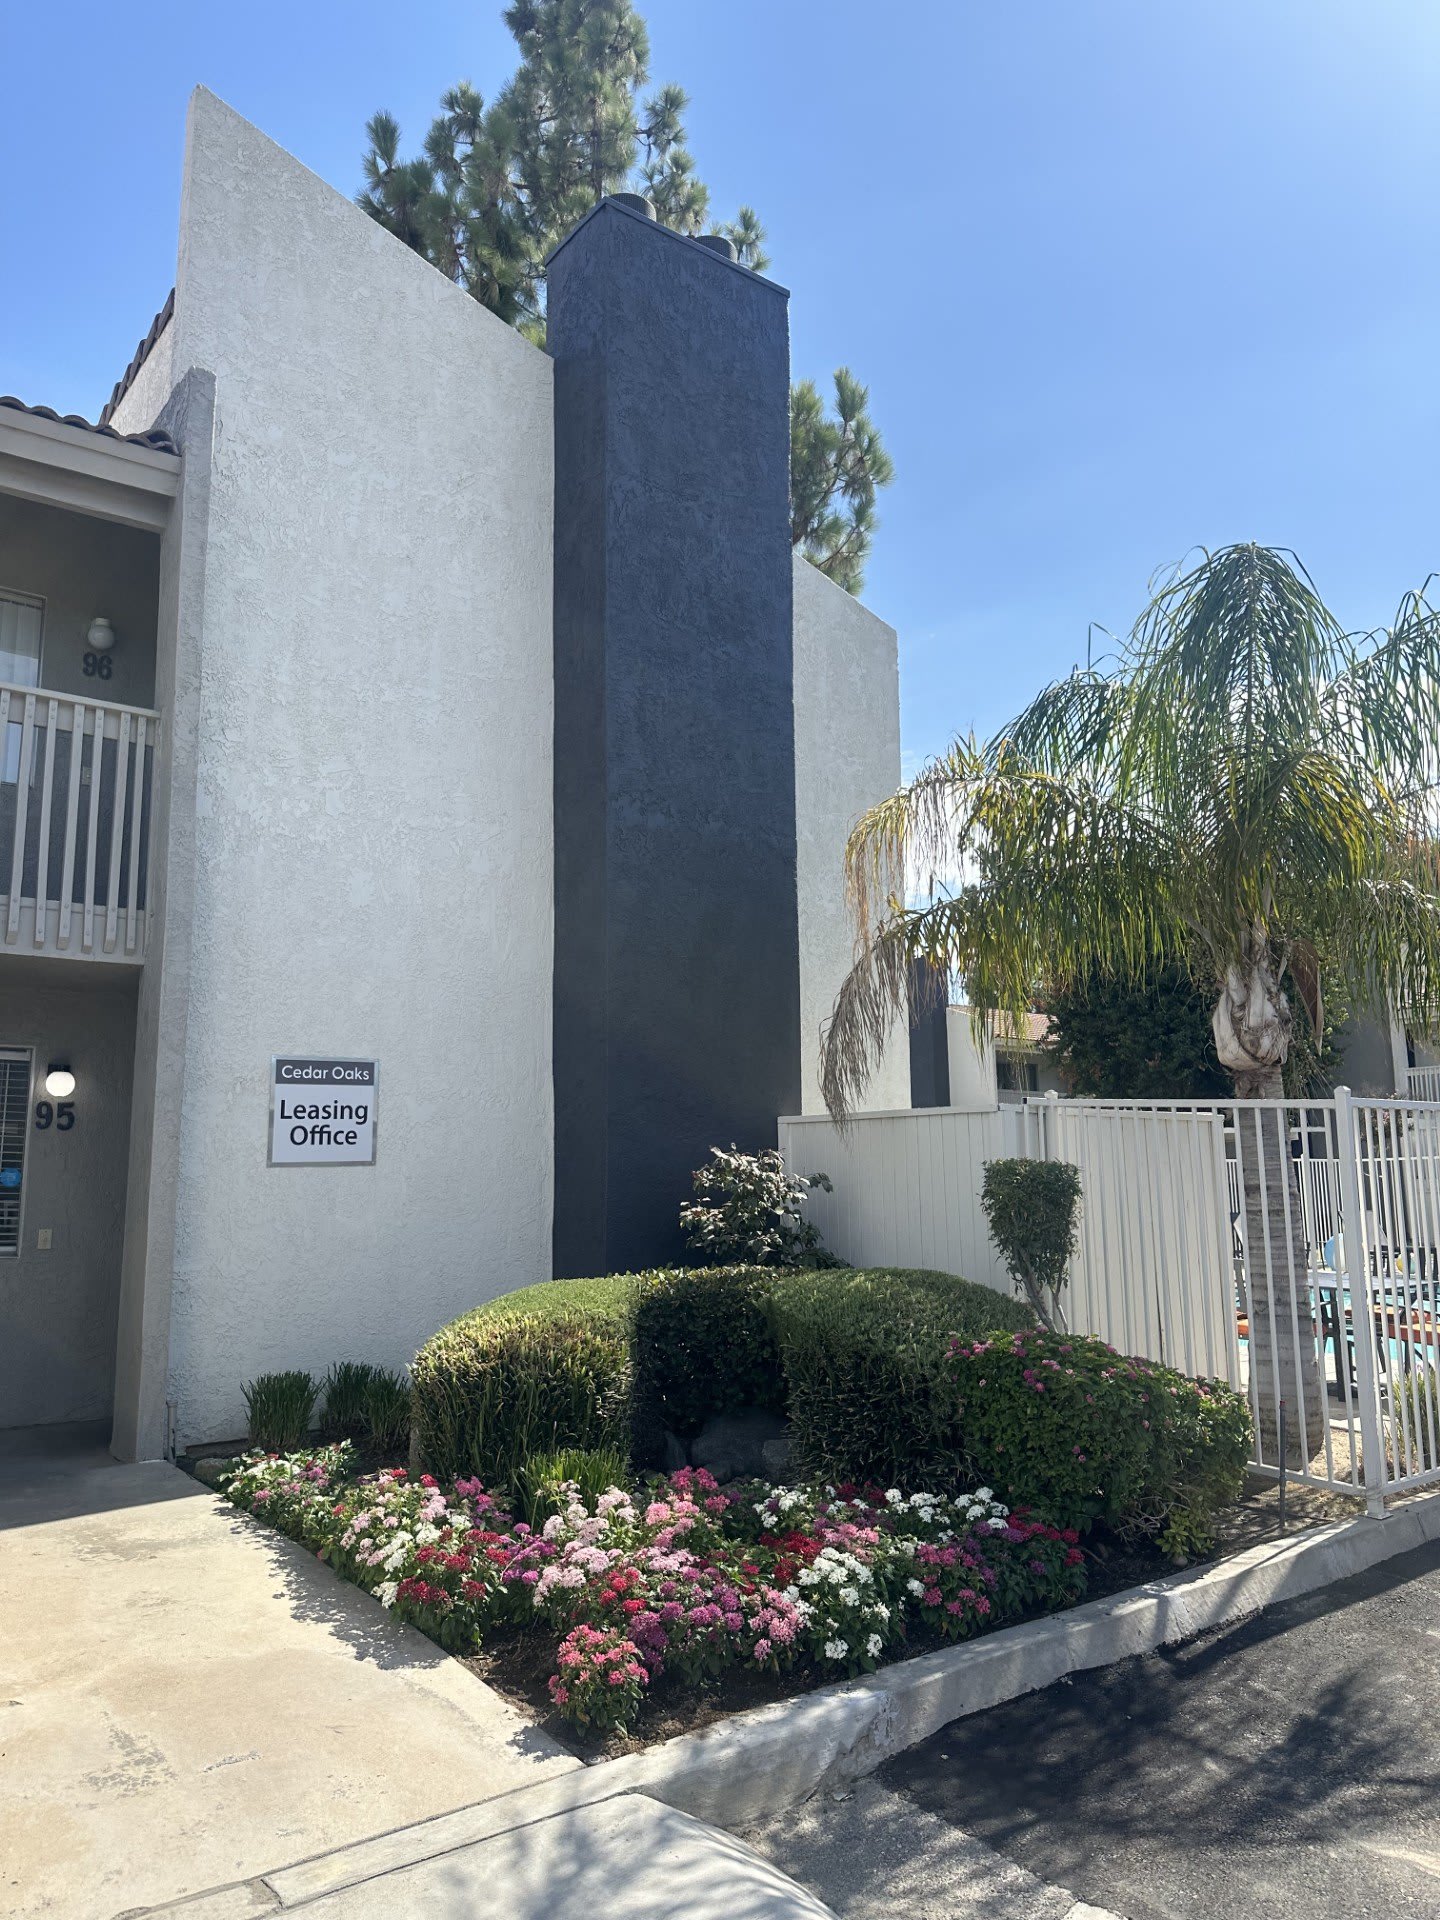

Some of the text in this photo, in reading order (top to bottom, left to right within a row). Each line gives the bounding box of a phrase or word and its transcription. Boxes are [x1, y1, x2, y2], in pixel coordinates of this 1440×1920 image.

[83, 652, 113, 681] 96
[281, 1065, 370, 1080] Cedar Oaks
[35, 1101, 76, 1131] 95
[280, 1099, 368, 1125] Leasing
[289, 1124, 358, 1146] Office
